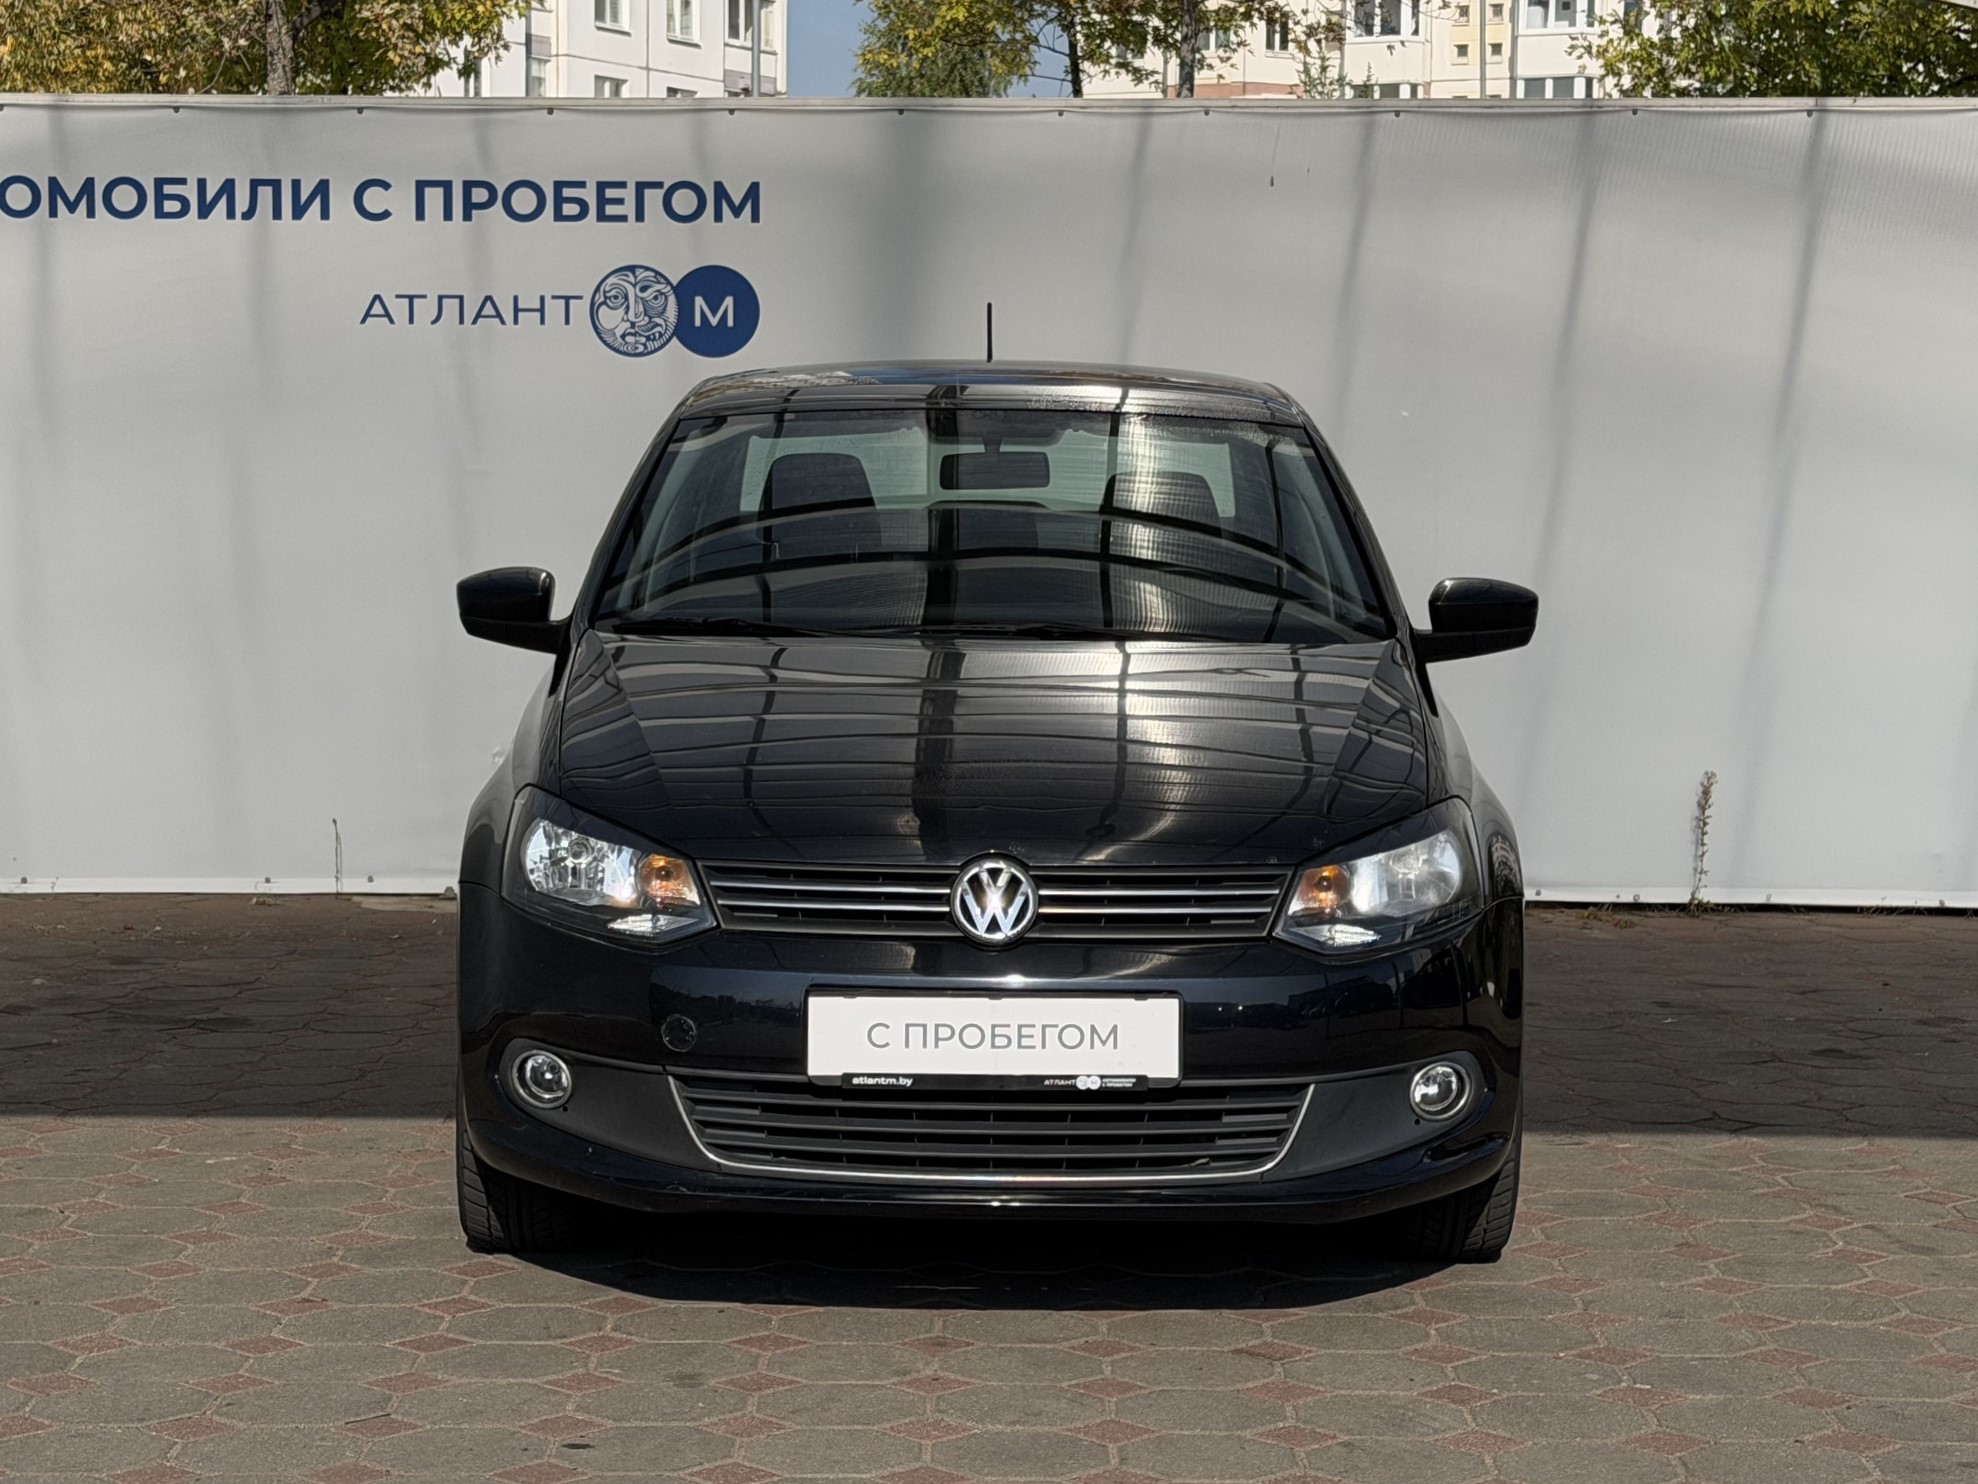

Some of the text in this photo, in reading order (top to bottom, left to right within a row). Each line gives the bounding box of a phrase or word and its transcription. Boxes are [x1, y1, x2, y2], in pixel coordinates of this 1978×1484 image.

[0, 175, 761, 224] ОМОБИЛИ С ПРОБЕГОМ
[359, 294, 584, 326] АТЛАНТ
[867, 1022, 1119, 1050] С ПРОБЕГОМ
[852, 1076, 913, 1087] atlantm.by
